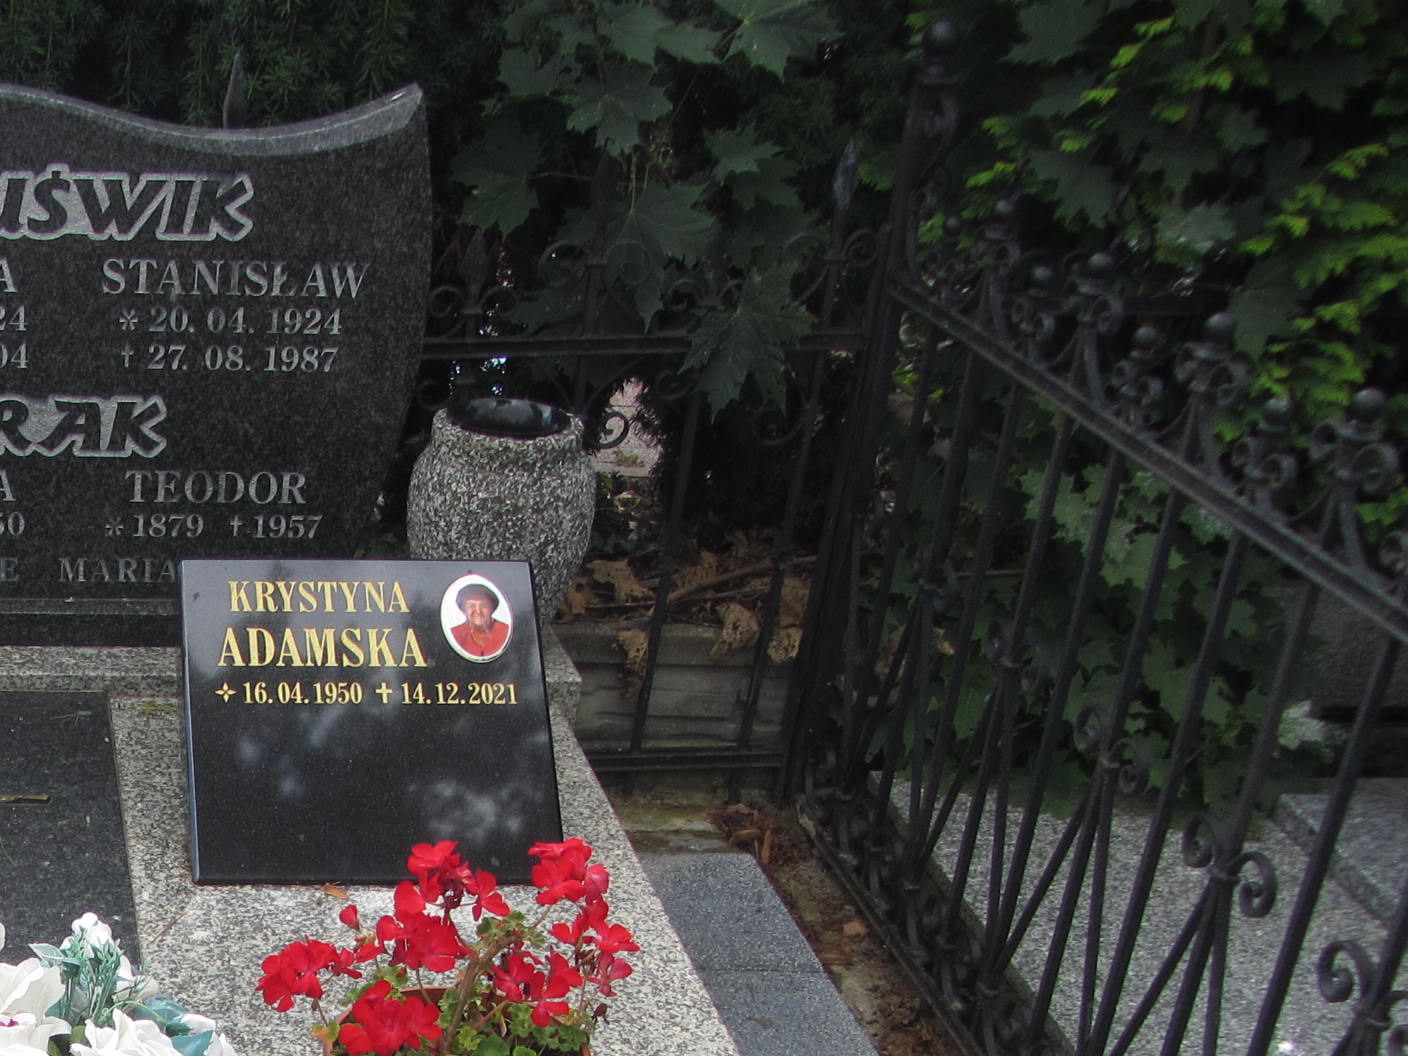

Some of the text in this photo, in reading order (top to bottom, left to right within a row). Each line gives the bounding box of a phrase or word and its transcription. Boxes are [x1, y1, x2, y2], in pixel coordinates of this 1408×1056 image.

[101, 258, 371, 299] STANISŁAW
[206, 306, 254, 334] 04.
[265, 307, 342, 335] 1924
[204, 345, 251, 371] 08.
[264, 346, 339, 372] 1987
[125, 470, 307, 504] TEODOR
[133, 513, 323, 539] 1879 1957
[58, 557, 178, 583] MARIA
[228, 580, 410, 613] KRYSTYNA
[217, 626, 428, 668] ADAMSKA
